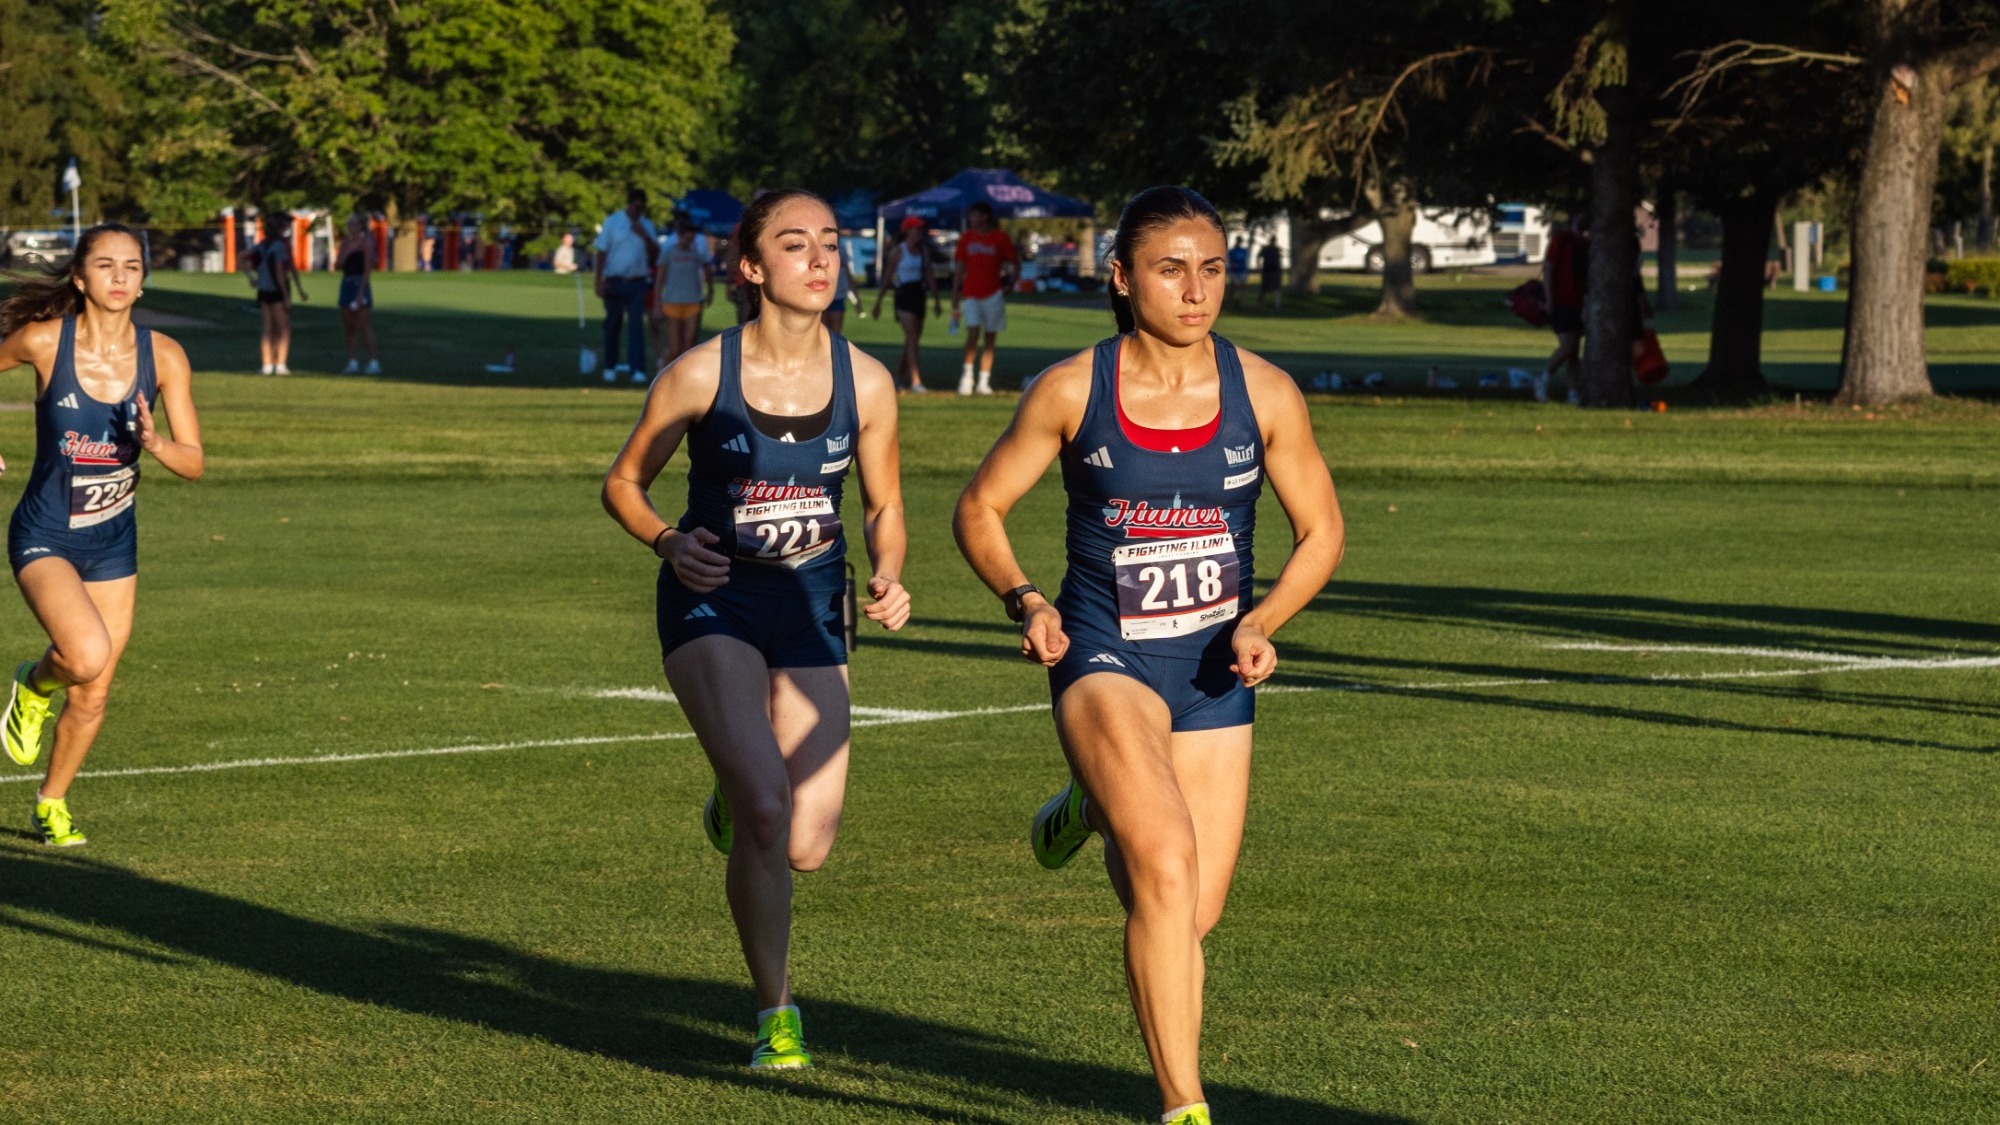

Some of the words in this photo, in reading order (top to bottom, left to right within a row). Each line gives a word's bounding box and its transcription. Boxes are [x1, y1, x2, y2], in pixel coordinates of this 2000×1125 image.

[61, 431, 131, 457] Flam
[1223, 442, 1255, 465] VALLEY
[746, 501, 797, 516] FIGHTING
[799, 500, 824, 510] ILLINI
[1105, 499, 1227, 529] Flames
[756, 519, 822, 557] 221
[1127, 542, 1188, 557] FIGHTING
[1190, 537, 1224, 551] ILLINI
[1138, 559, 1222, 611] 218
